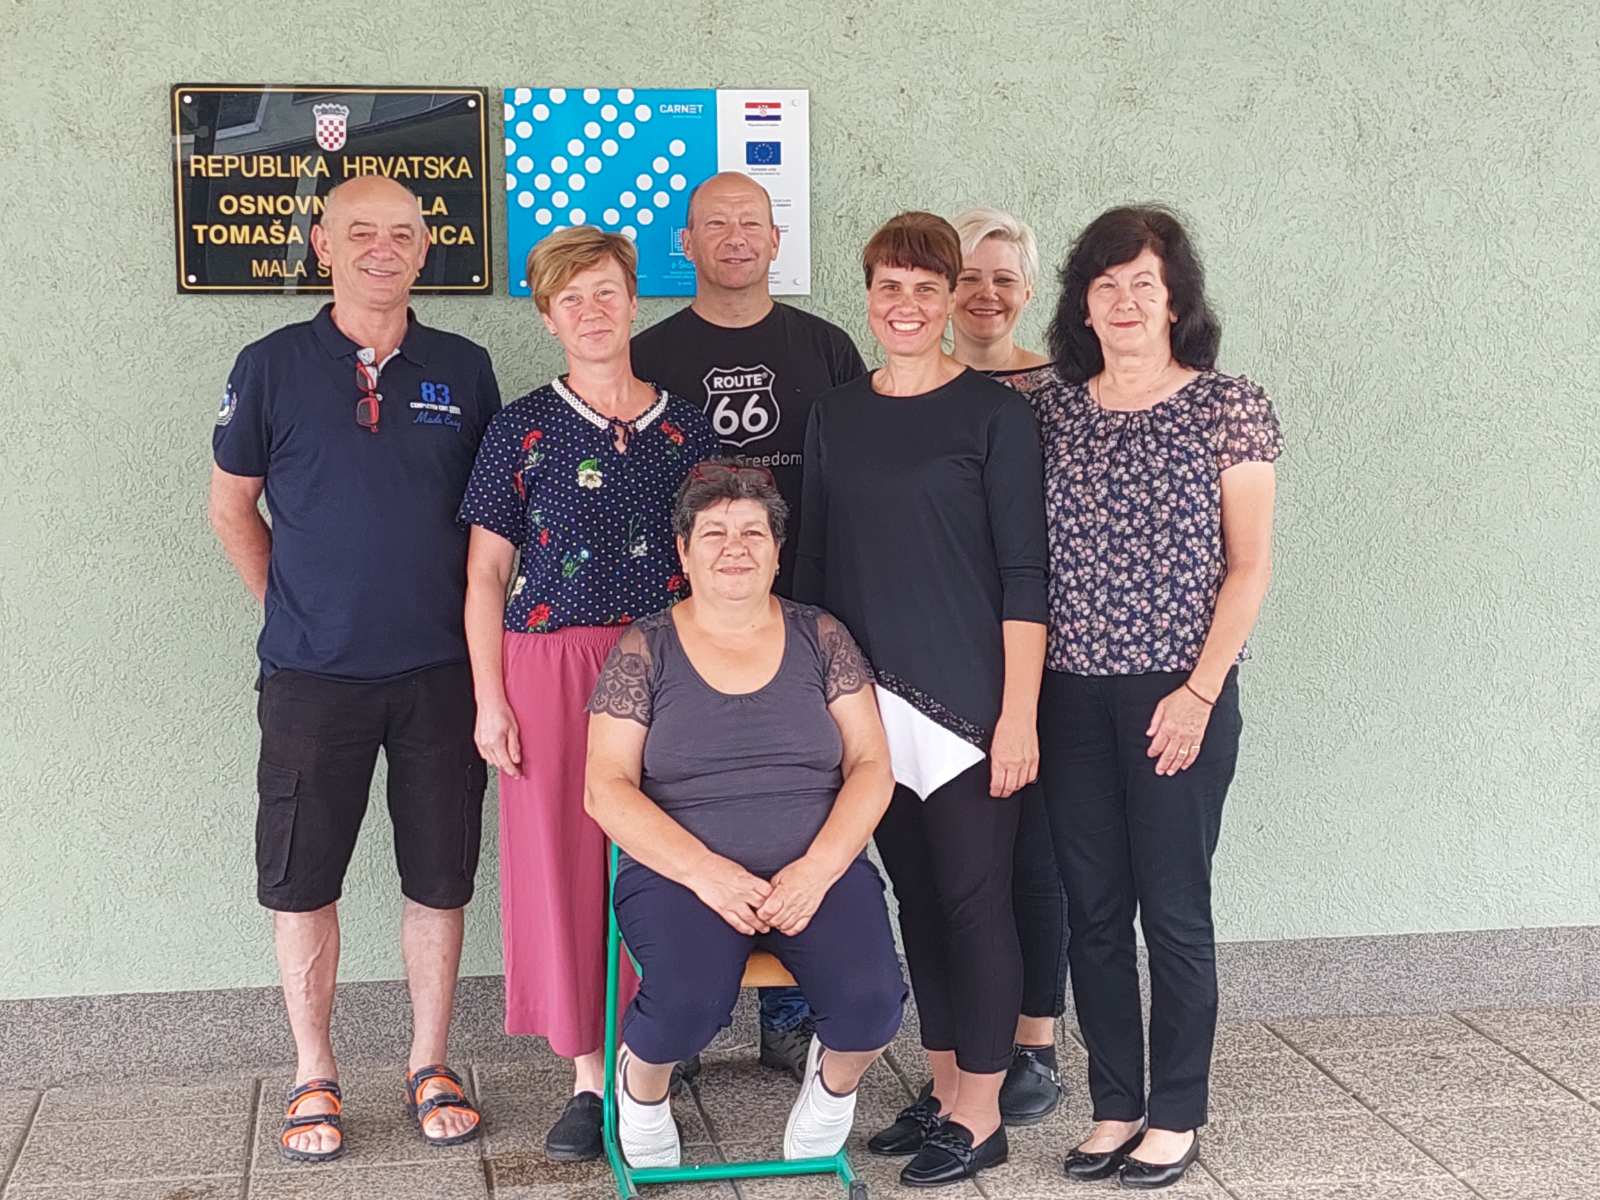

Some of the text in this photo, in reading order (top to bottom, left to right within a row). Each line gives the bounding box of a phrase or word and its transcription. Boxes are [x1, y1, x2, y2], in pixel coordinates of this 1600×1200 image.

[659, 103, 704, 114] CARNET
[189, 155, 474, 179] REPUBLIKA HRVATSKA
[219, 195, 328, 216] OSNOVN
[192, 220, 304, 245] TOMAŠA
[251, 259, 307, 278] MALA
[421, 382, 450, 404] 83
[712, 393, 769, 436] 66
